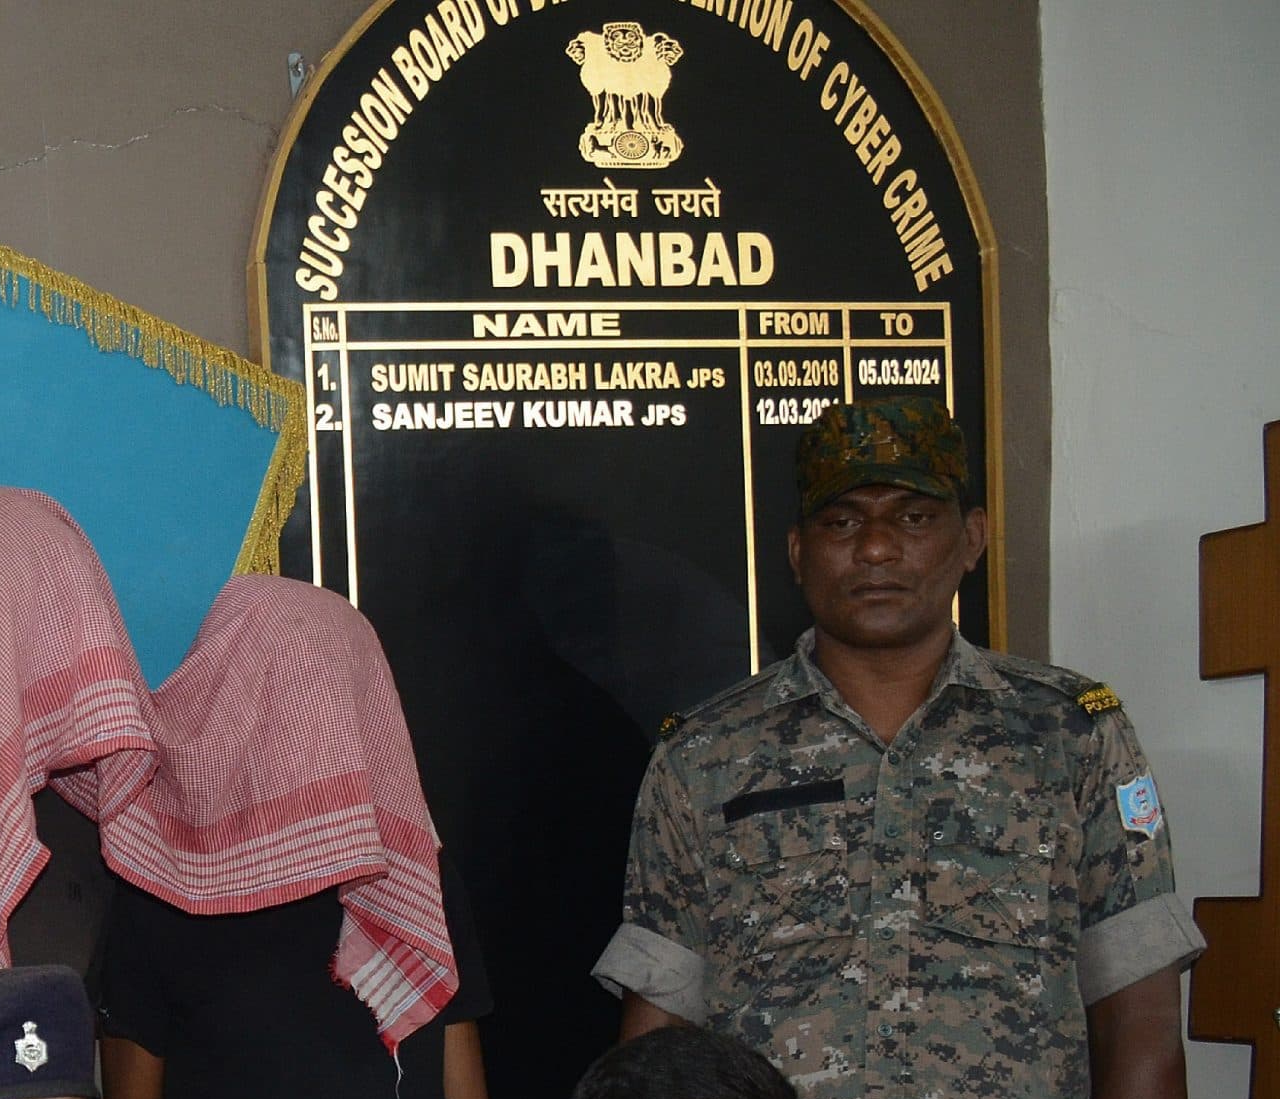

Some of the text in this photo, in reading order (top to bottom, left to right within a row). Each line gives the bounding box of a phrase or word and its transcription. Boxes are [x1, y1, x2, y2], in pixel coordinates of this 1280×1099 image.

[295, 68, 413, 301] SUCCESSION
[391, 0, 486, 101] BOARD
[787, 18, 831, 81] OF
[820, 61, 902, 185] CYBER
[883, 169, 954, 293] CRIME
[540, 177, 722, 218] सत्यमेव जयते
[489, 231, 775, 288] DHANBAD
[312, 316, 339, 342] S.No.
[473, 312, 621, 338] NAME
[759, 312, 831, 335] FROM
[879, 312, 914, 336] TO
[317, 359, 940, 392] 1. SUMIT SAURABH LAKRA JPS 03.09.2018 05.03.2024
[315, 398, 839, 431] 2. SANJEEV KUMAR JPS 12.03.20
